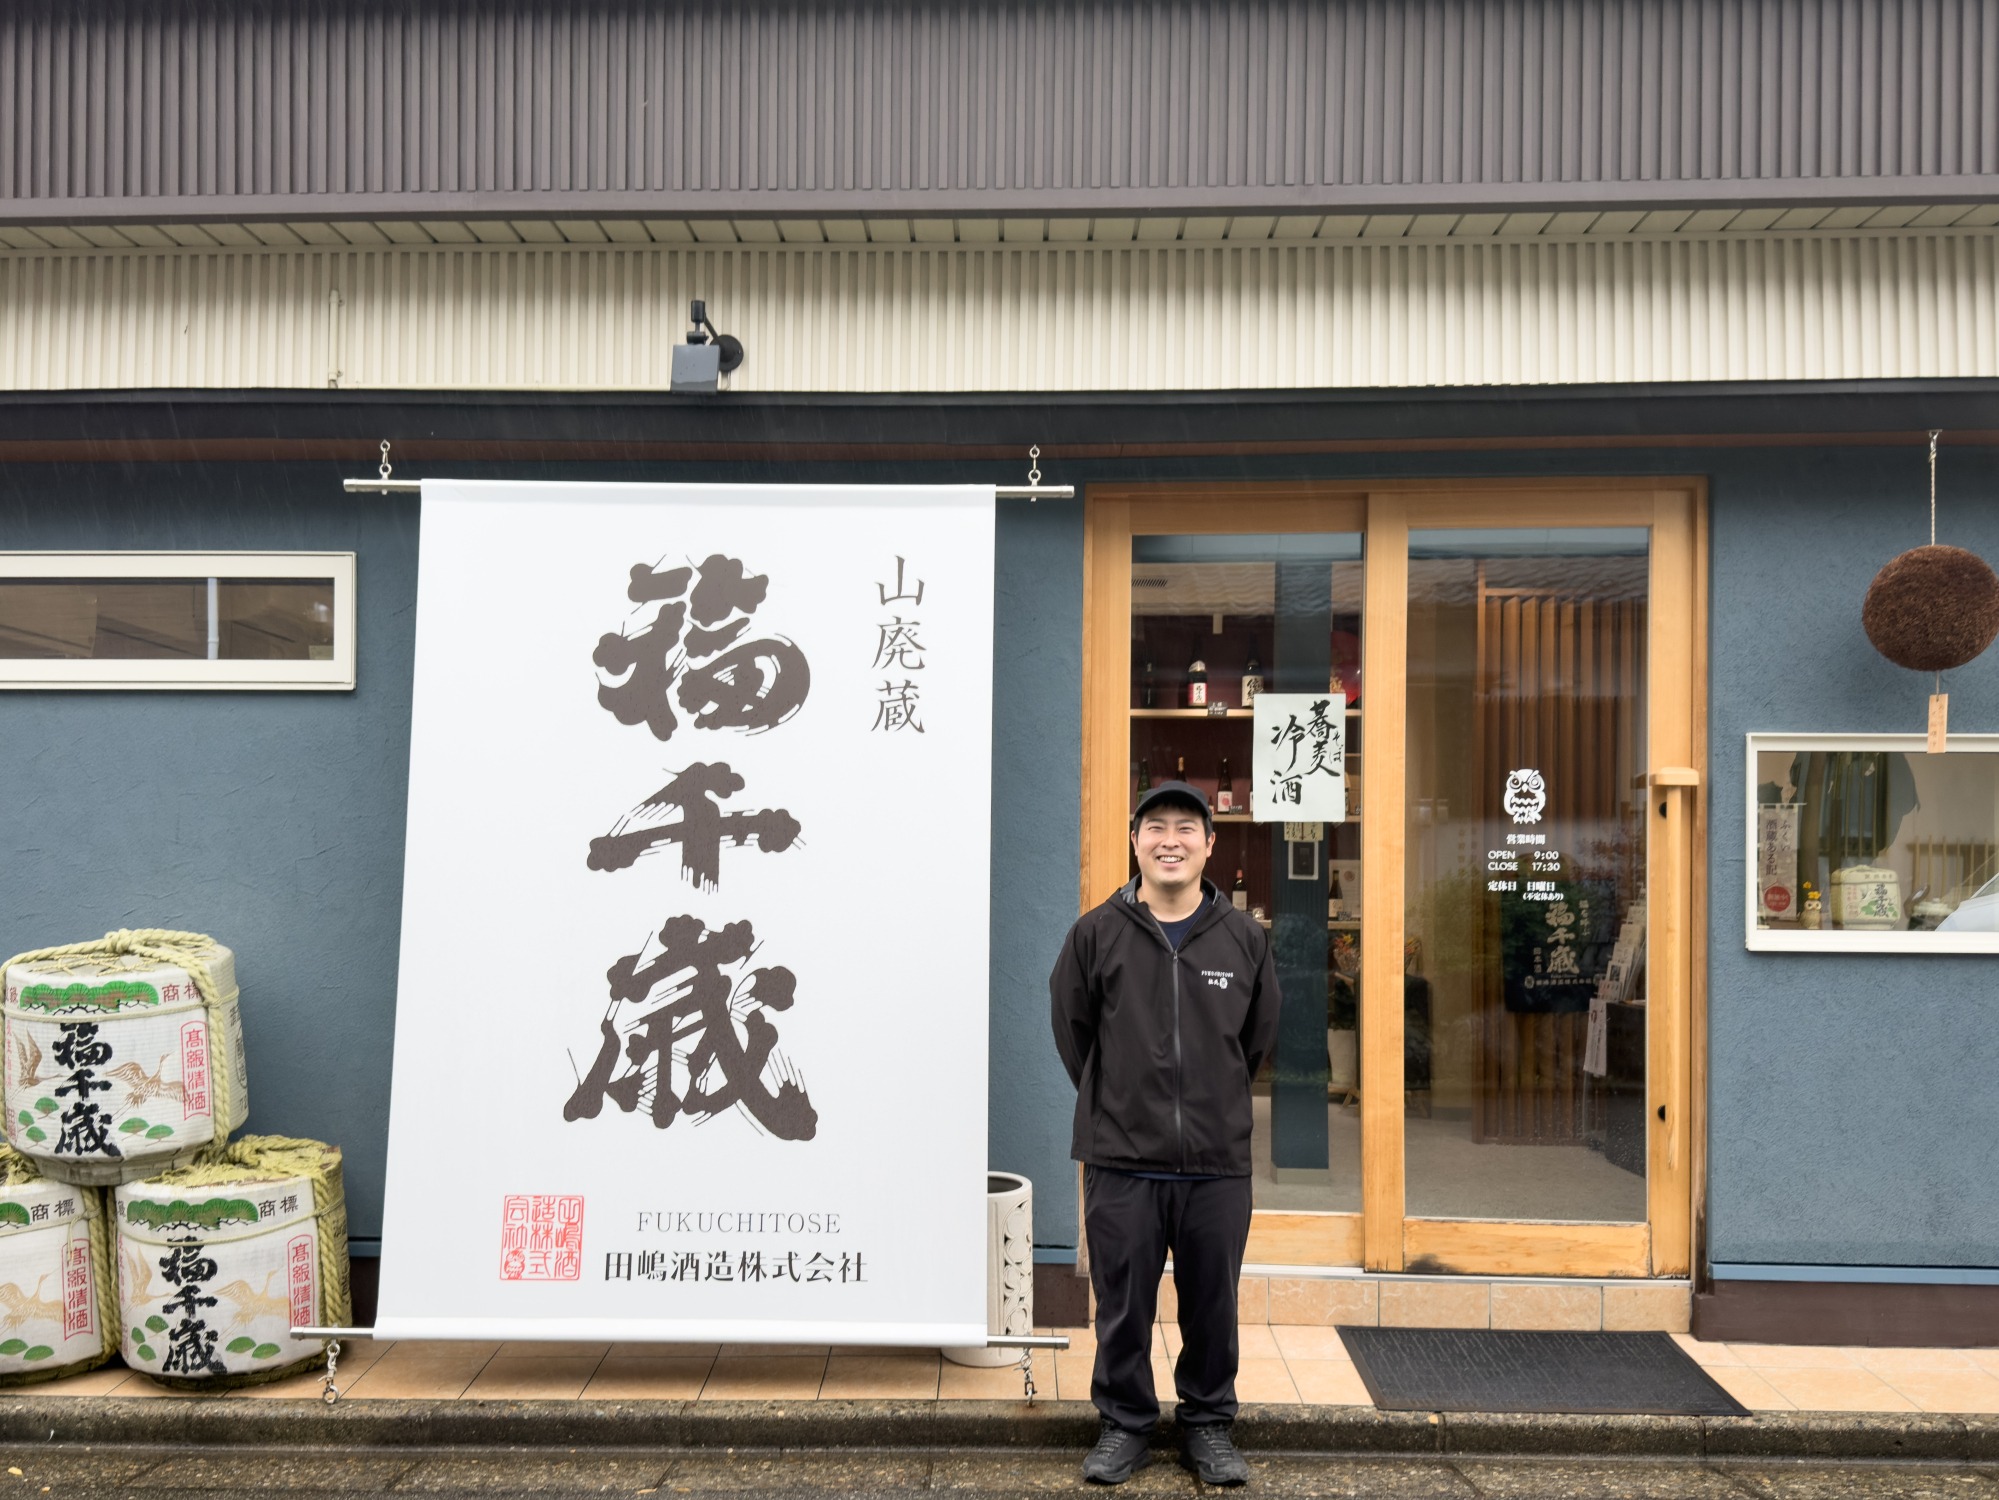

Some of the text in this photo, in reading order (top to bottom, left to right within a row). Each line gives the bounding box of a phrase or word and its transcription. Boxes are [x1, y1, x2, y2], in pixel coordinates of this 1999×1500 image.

[871, 555, 927, 733] 山廃蔵
[1305, 700, 1341, 777] 蕎麦
[1270, 714, 1306, 805] 冷酒
[563, 553, 818, 1141] 福千歳
[1488, 850, 1559, 860] OPEN 9:00
[1506, 834, 1546, 845] 営業時間
[1488, 862, 1560, 871] CLOSE 17:30
[1488, 880, 1555, 891] 定休日 日曜日
[1545, 901, 1580, 974] 福千歳
[52, 1023, 122, 1157] 福千歳
[30, 1198, 76, 1221] 商標
[259, 1194, 299, 1218] 商標
[637, 1211, 841, 1234] FUKUCHITOSE
[604, 1250, 868, 1283] 田嶋酒造株式会社
[159, 1236, 228, 1375] 福千歳
